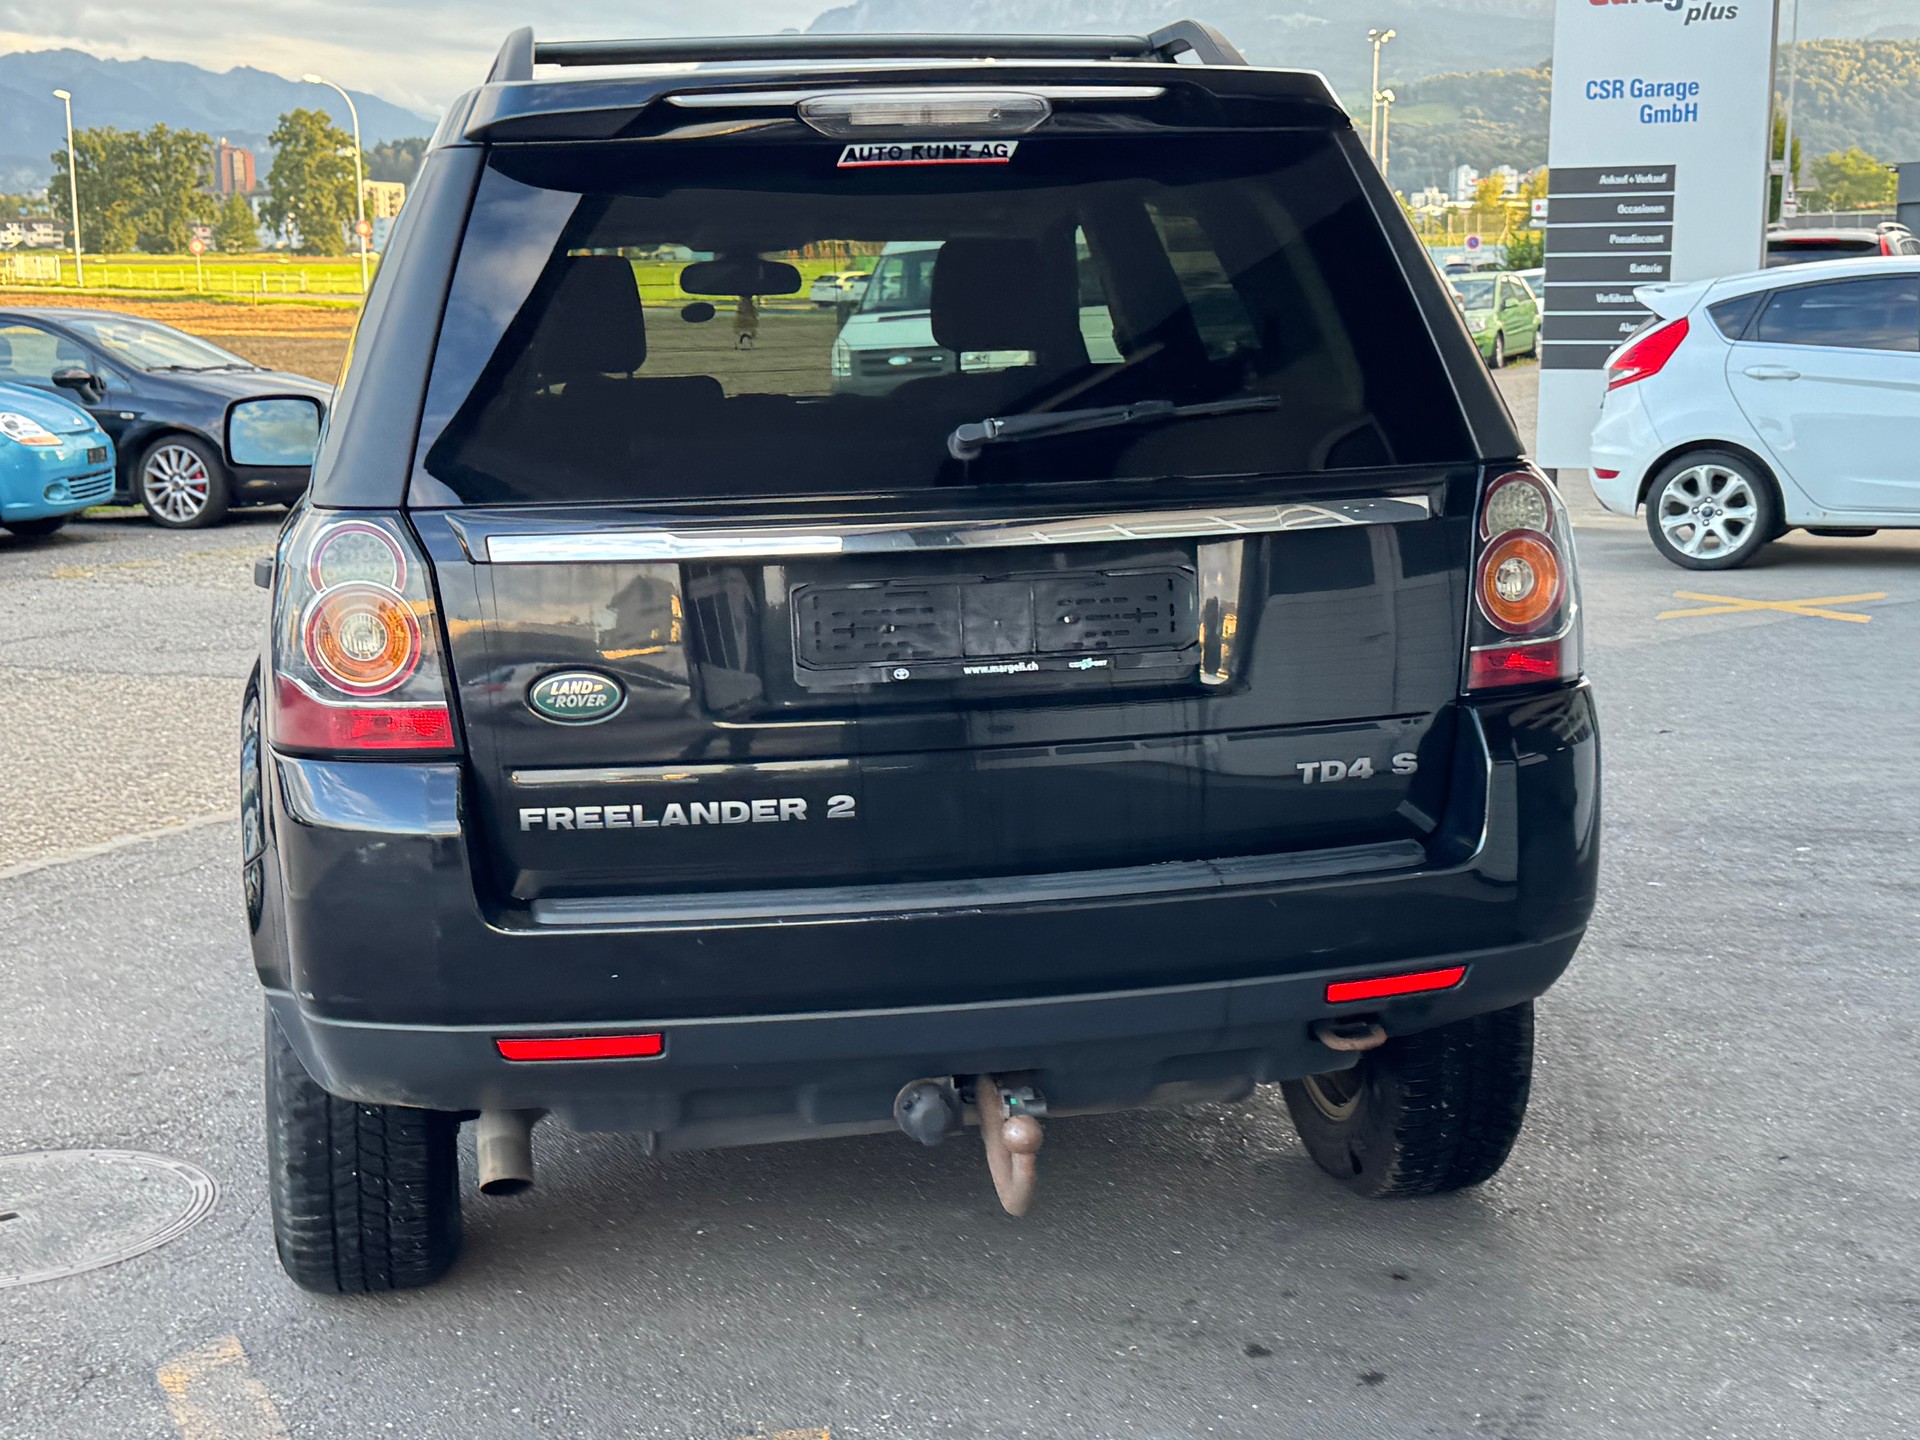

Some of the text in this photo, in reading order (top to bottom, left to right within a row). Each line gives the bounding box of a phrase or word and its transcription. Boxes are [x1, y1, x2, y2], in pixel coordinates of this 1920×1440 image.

[1684, 1, 1738, 26] plus
[1586, 78, 1699, 101] CSR Garage
[1640, 102, 1698, 124] GmbH
[843, 143, 1009, 163] AUTO KUNZ AG
[1635, 173, 1667, 184] Verkauf
[1617, 203, 1666, 215] Occasionen
[1629, 263, 1663, 274] Batterie
[550, 680, 593, 696] LAND
[555, 694, 608, 708] ROVER
[1296, 752, 1418, 785] TD4 S
[519, 795, 856, 831] FREELANDER 2
